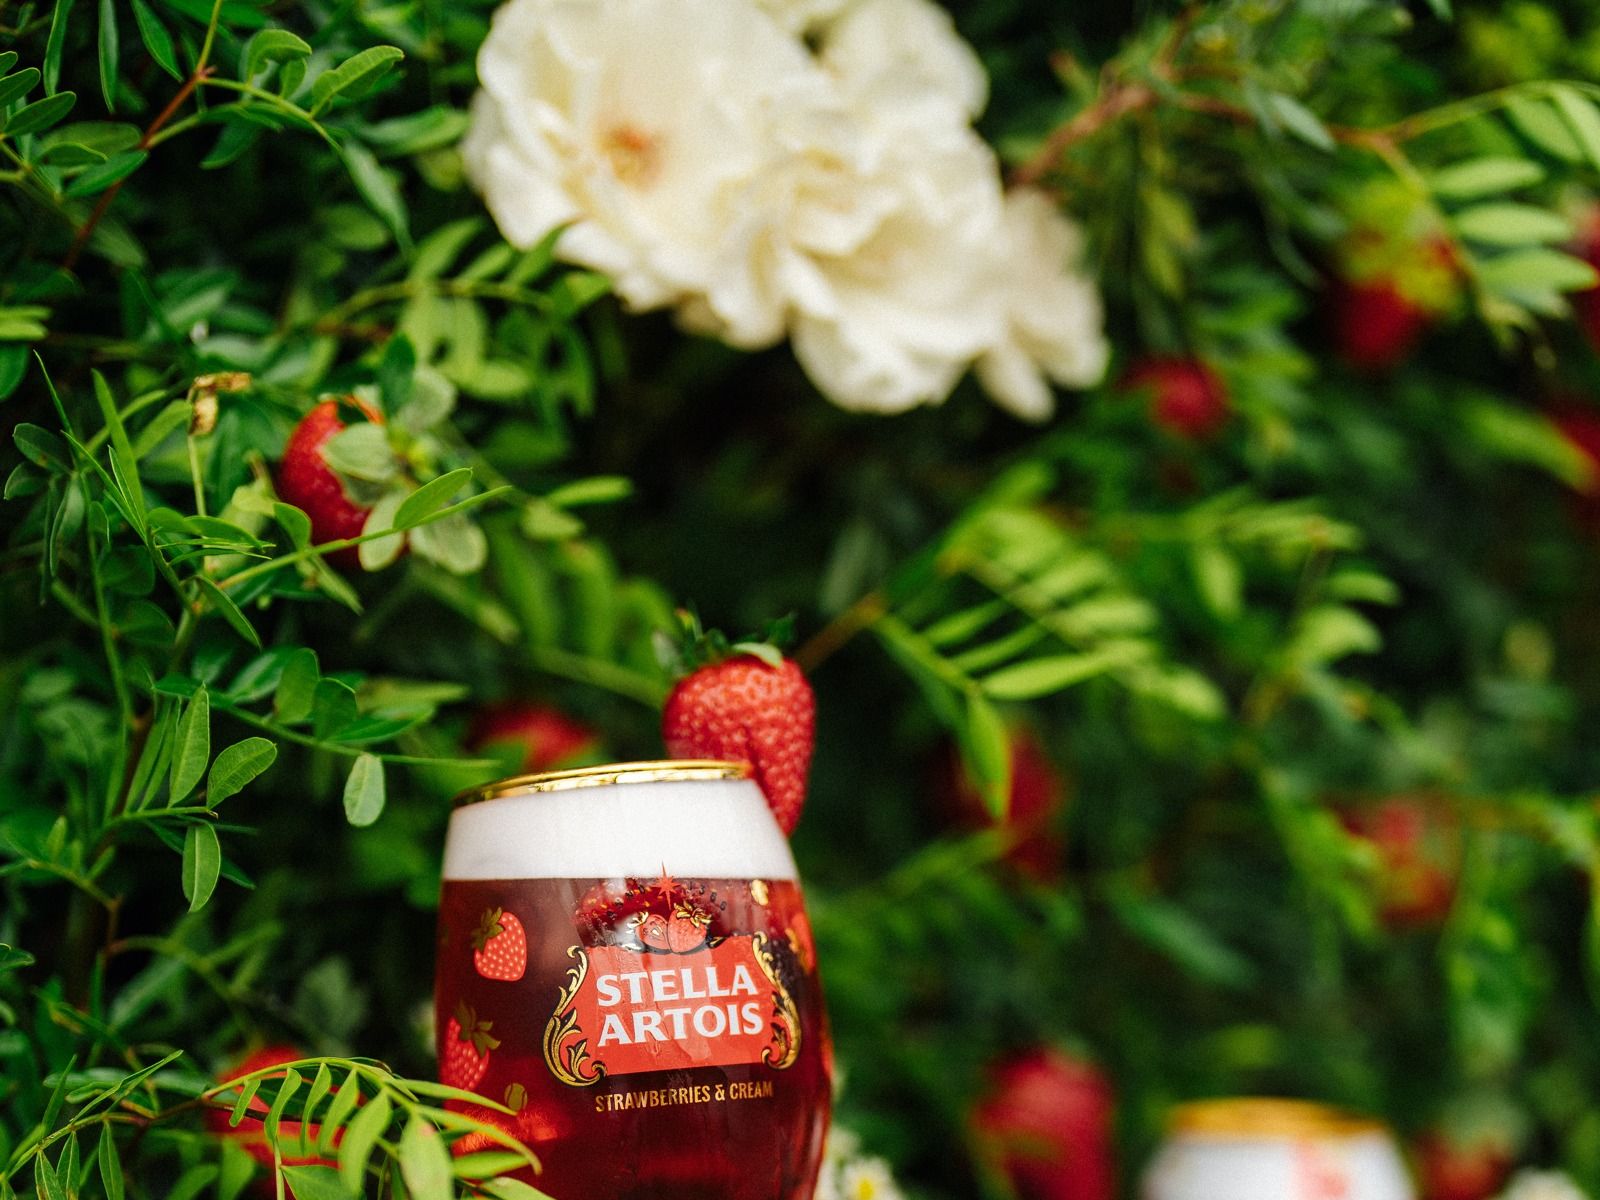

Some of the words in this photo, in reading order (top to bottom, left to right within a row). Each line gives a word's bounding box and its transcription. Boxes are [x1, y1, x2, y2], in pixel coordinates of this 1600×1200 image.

[596, 965, 757, 1007] STELLA
[597, 1003, 763, 1047] ARTOIS
[595, 1085, 711, 1112] STRAWBERRIES
[715, 1084, 725, 1101] &
[730, 1080, 773, 1101] CREAM
